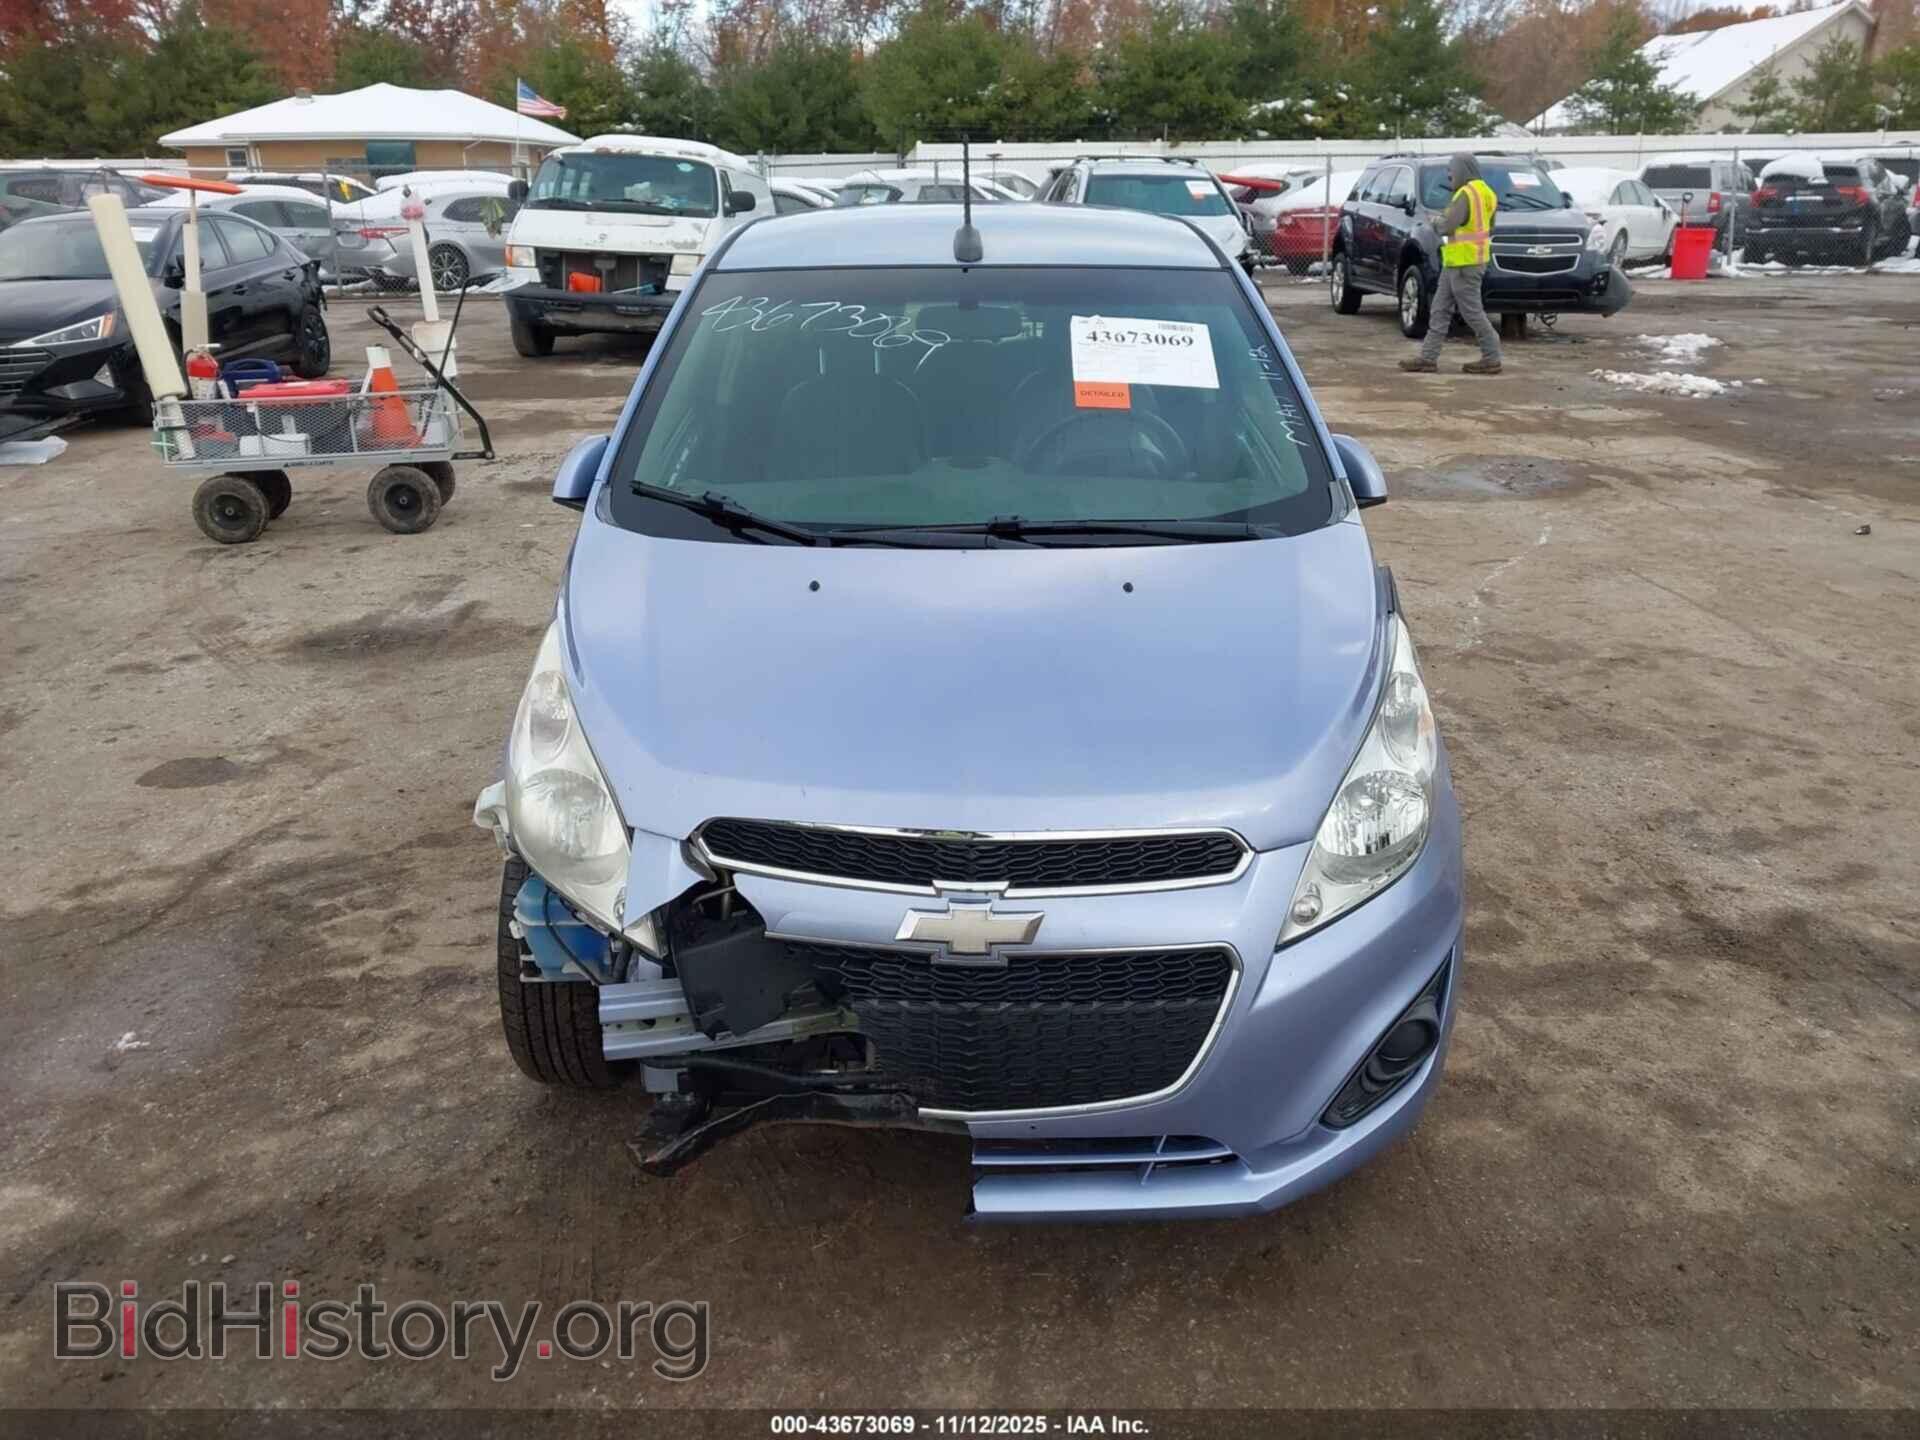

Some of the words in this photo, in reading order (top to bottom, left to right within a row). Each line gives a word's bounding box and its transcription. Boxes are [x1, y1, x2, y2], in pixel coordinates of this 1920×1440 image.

[701, 295, 951, 374] 43673069
[1086, 330, 1194, 347] 43673069
[1079, 390, 1125, 398] DETAILED
